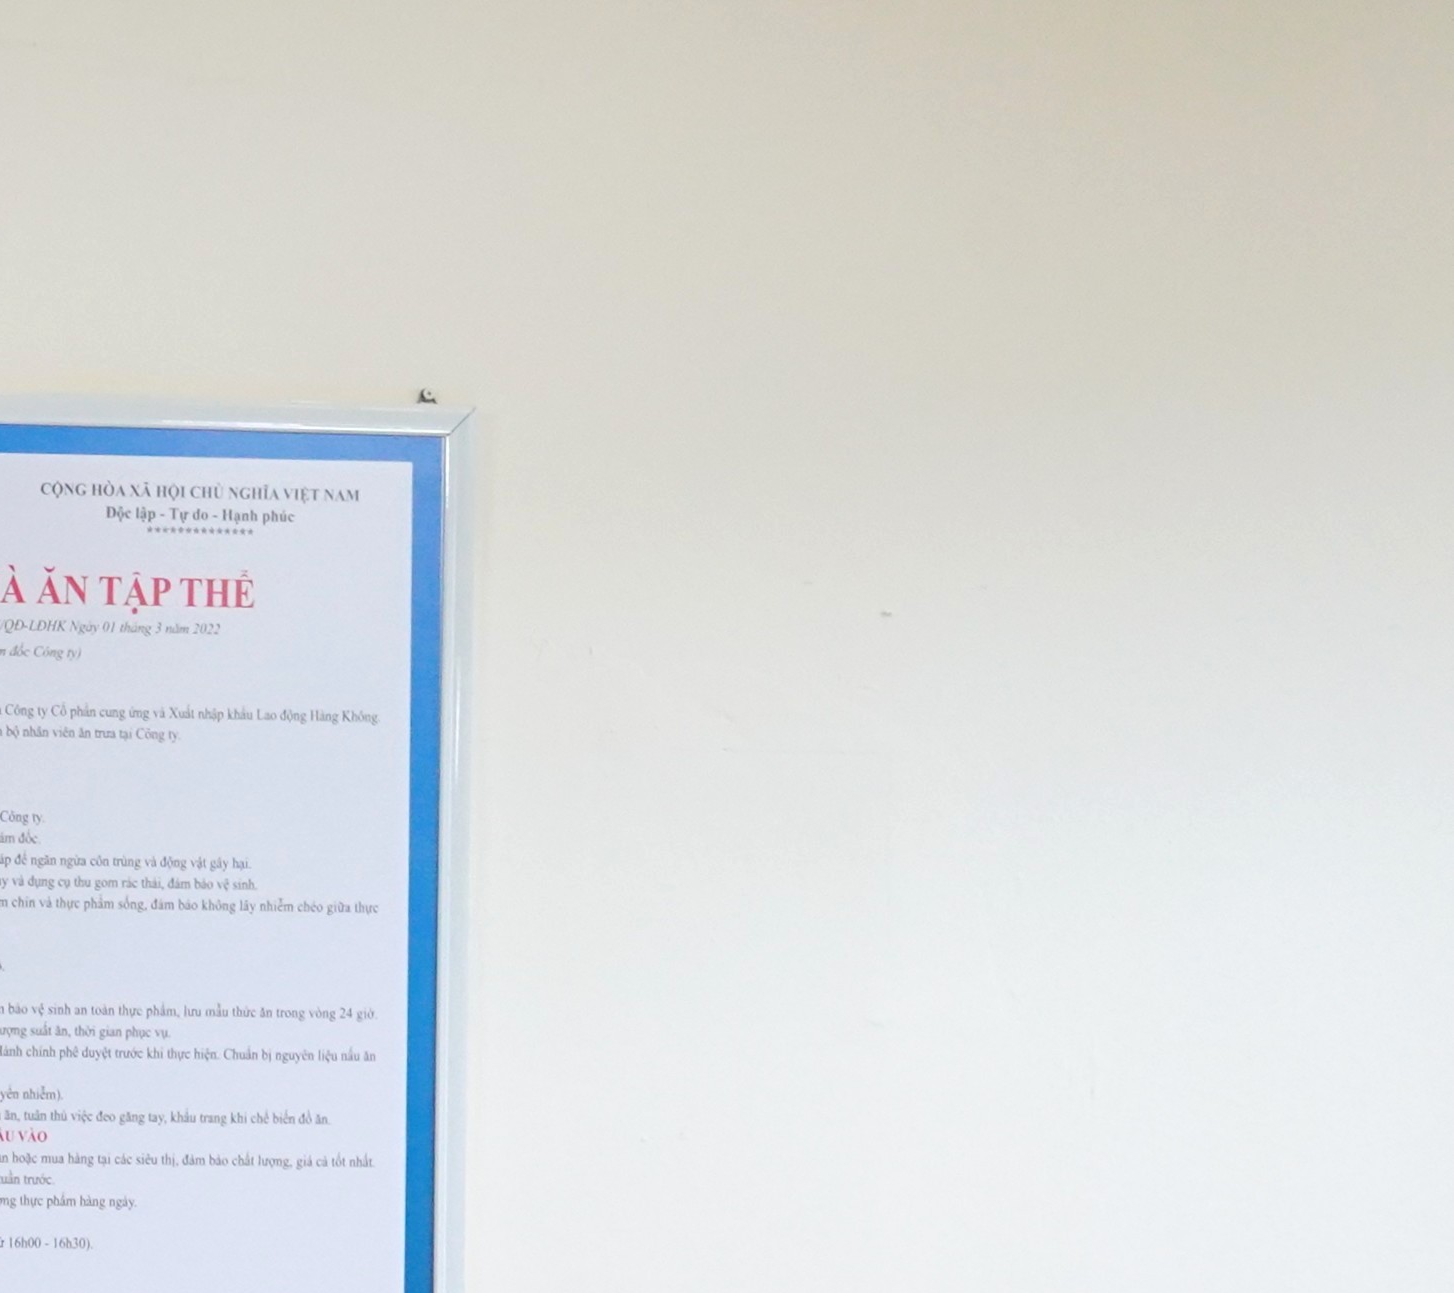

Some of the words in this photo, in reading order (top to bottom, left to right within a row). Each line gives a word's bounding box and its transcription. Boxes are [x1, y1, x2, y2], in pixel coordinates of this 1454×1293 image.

[41, 481, 86, 498] CỘNG
[92, 480, 125, 497] HÒA
[131, 483, 152, 498] XÃ
[157, 484, 186, 500] HỘI
[228, 486, 280, 501] NGHĨA
[282, 487, 319, 503] VIỆT
[325, 489, 359, 501] NAM
[106, 506, 132, 522] Độc
[135, 507, 157, 523] lập
[169, 508, 188, 523] Tự
[192, 509, 209, 521] do
[222, 510, 260, 524] Hạnh
[262, 511, 296, 525] phúc
[37, 567, 89, 606] ĂN
[99, 571, 173, 615] TẬP
[180, 569, 255, 610] THỂ
[101, 620, 116, 633] 01
[154, 621, 163, 635] 3
[164, 623, 190, 635] năm
[192, 622, 221, 636] 2022
[32, 645, 65, 662] Công
